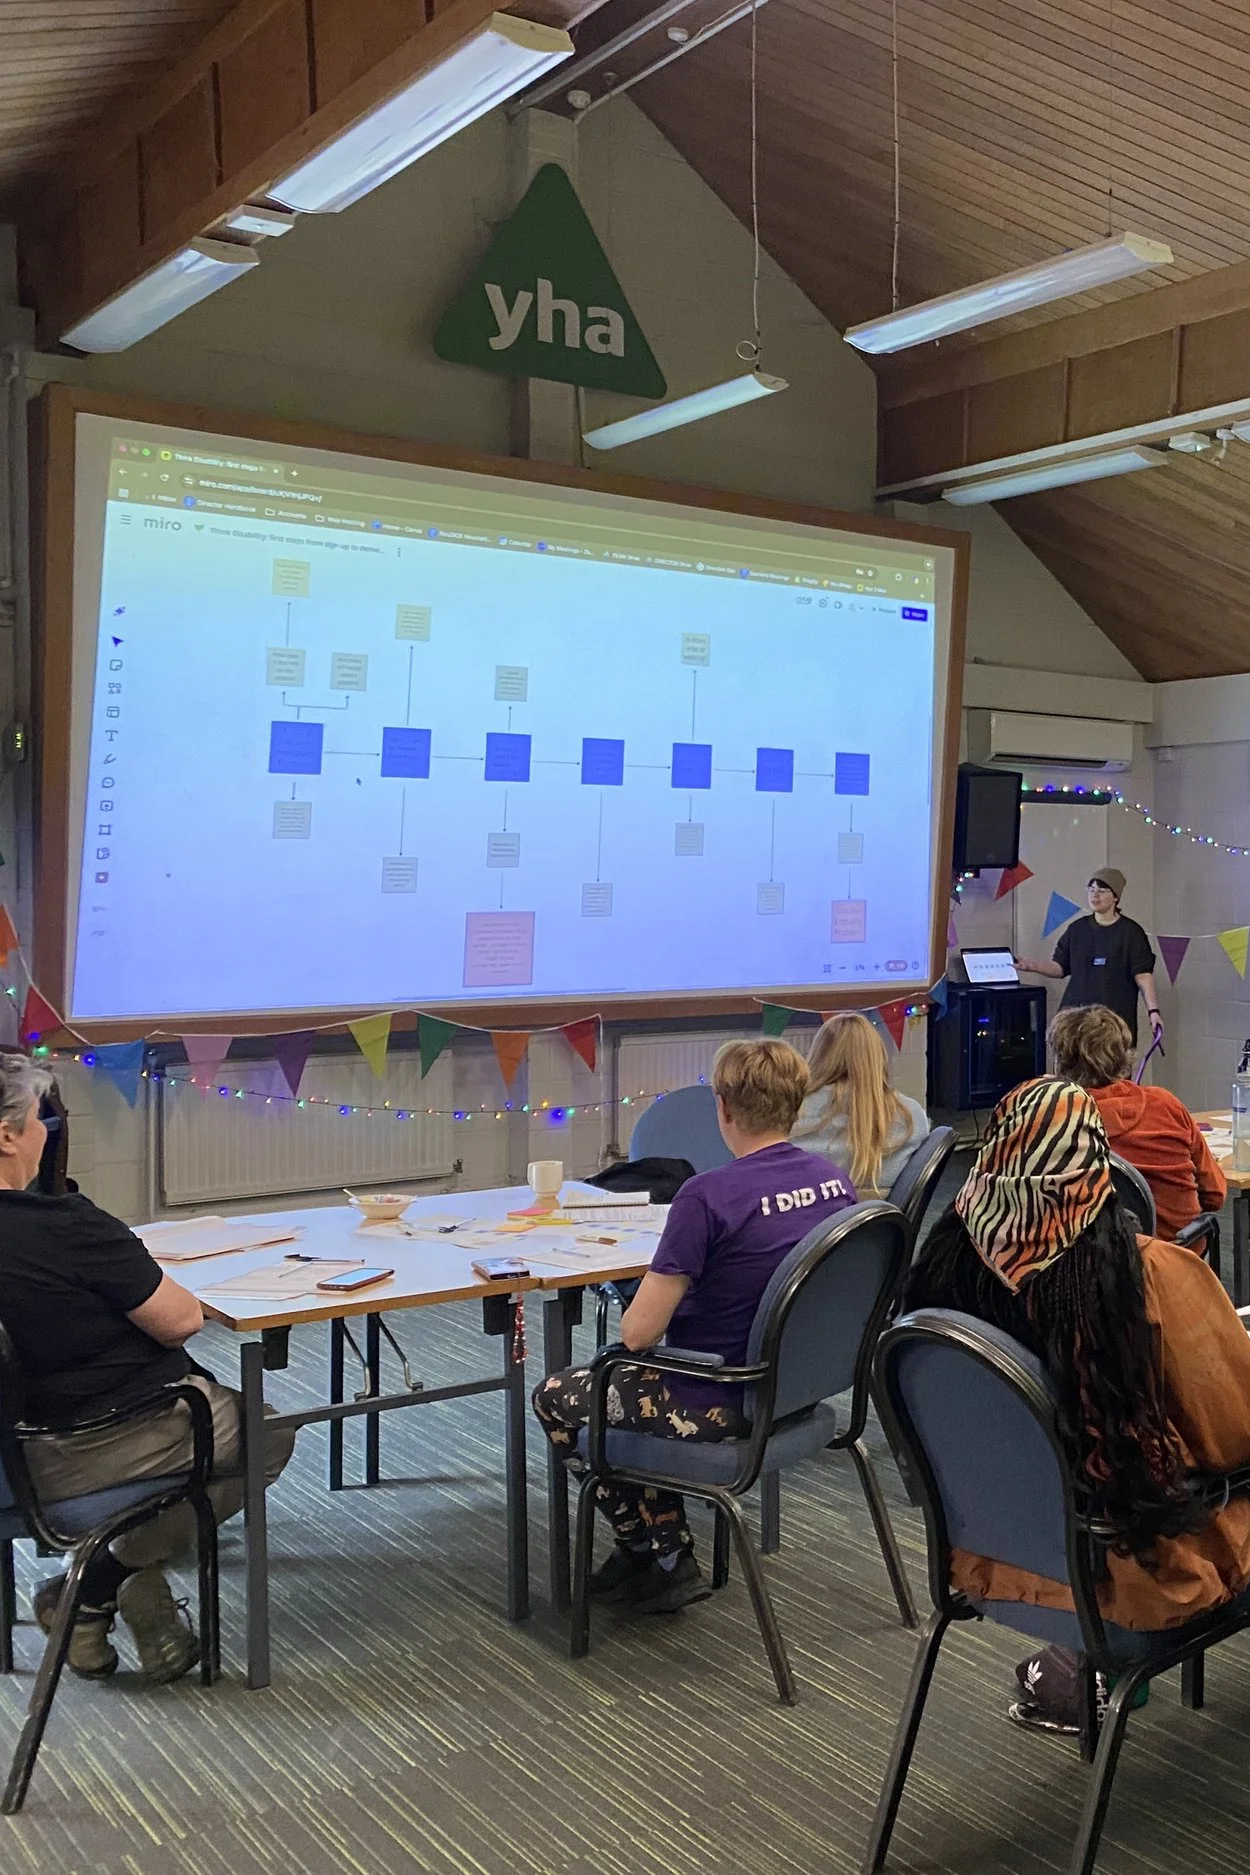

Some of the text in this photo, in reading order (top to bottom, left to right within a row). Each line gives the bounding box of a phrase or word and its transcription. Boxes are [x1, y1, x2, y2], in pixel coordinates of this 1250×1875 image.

[484, 277, 625, 357] yha
[144, 517, 182, 531] miro
[760, 1179, 847, 1216] I DID IT!
